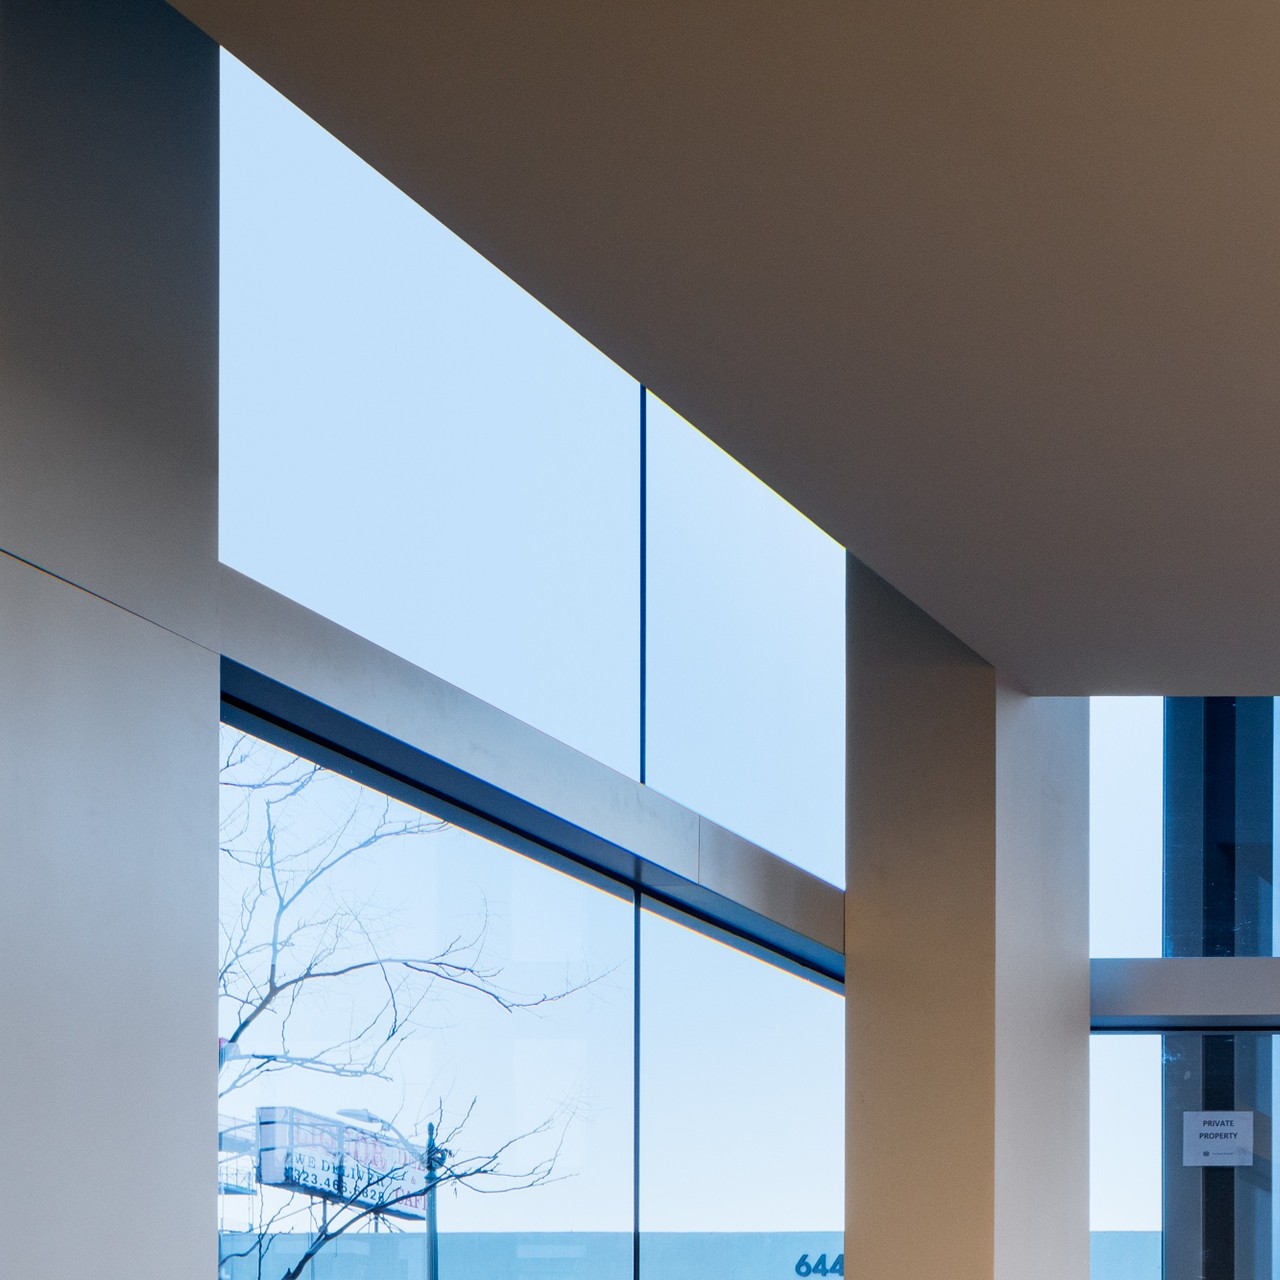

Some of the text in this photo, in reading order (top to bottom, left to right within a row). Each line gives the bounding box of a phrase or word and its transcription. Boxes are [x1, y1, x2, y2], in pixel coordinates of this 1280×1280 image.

[1199, 1132, 1238, 1140] PROPERTY
[295, 1154, 316, 1168] WE
[795, 1254, 844, 1277] 644
